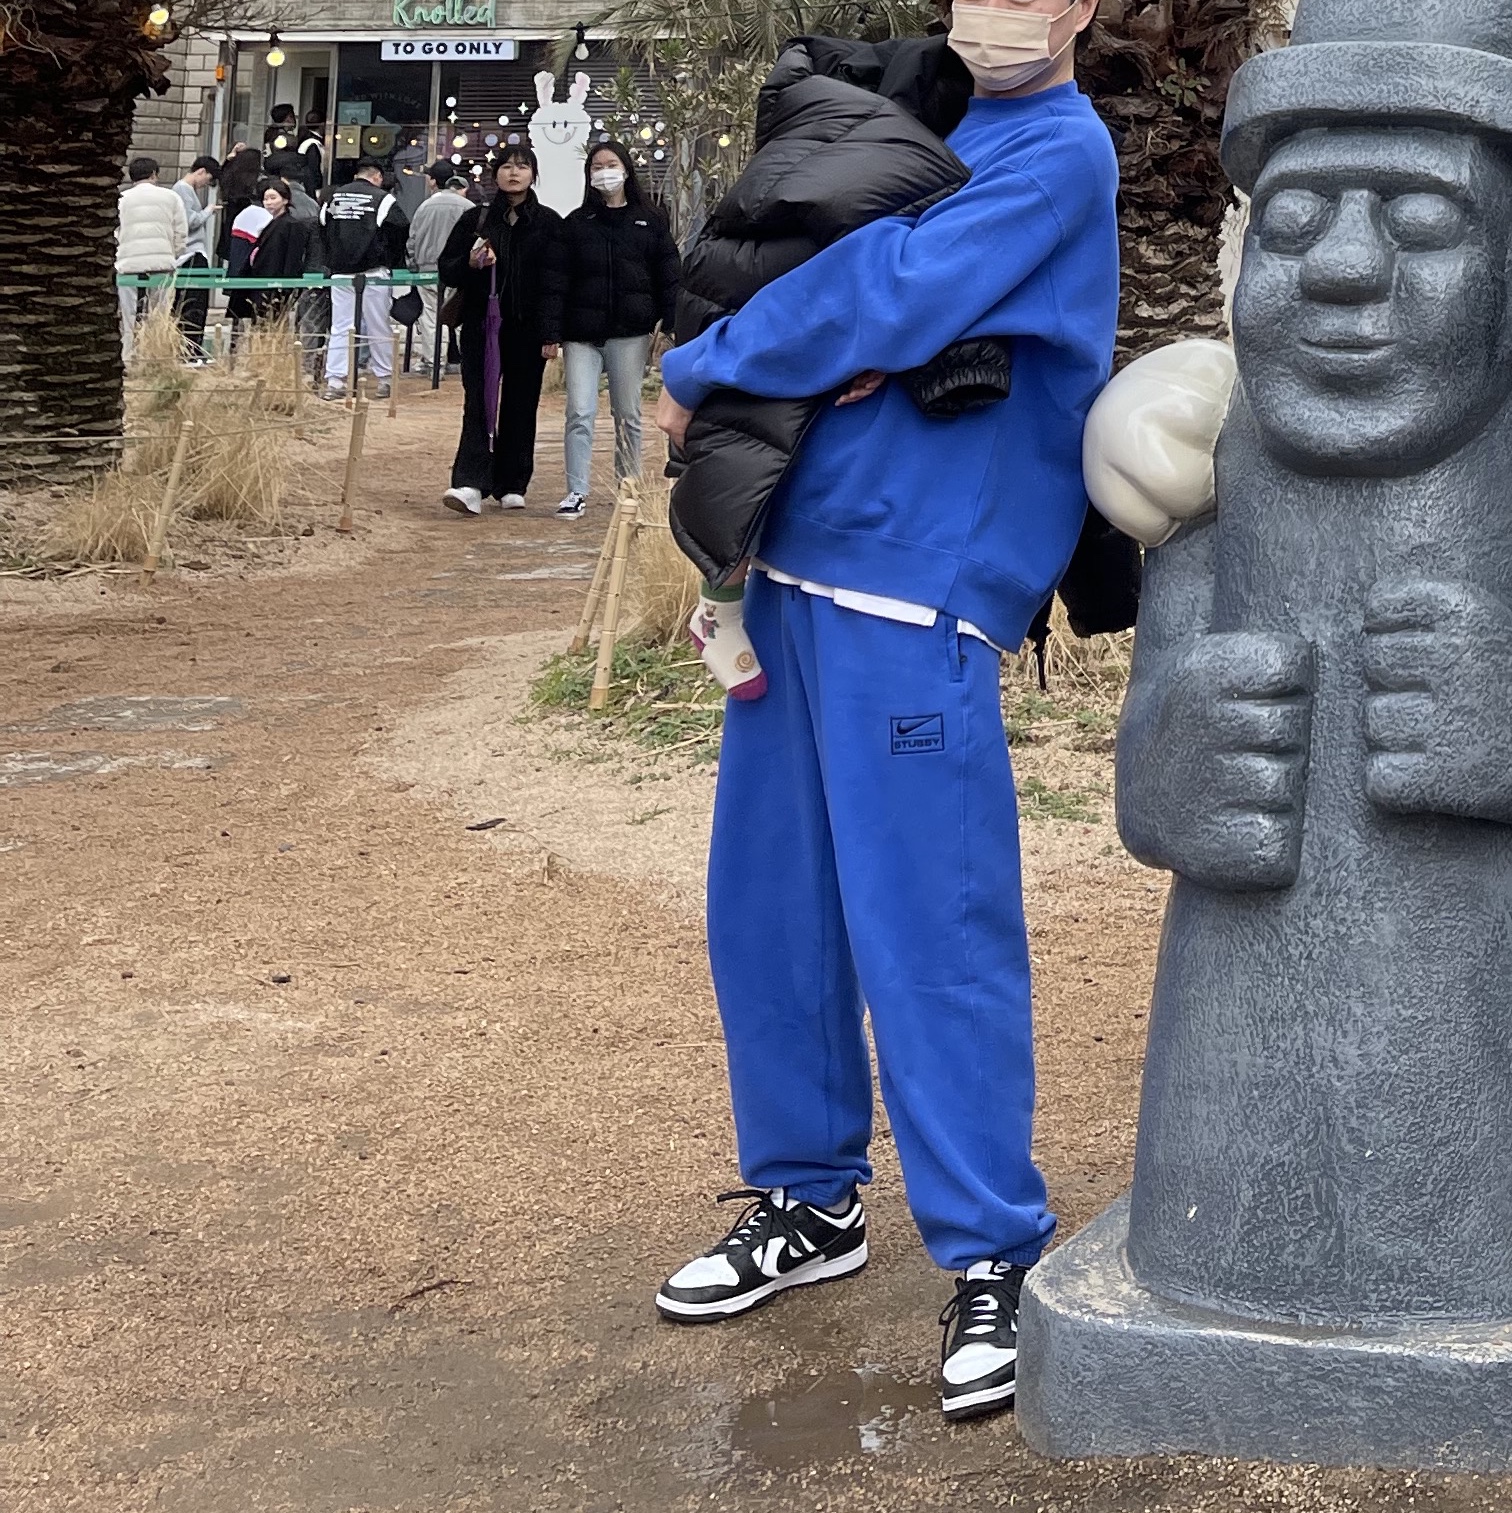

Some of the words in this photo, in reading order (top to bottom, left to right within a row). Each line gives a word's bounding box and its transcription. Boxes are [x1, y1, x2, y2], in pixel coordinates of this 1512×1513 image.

[392, 42, 415, 55] TO
[421, 42, 448, 55] GO
[454, 42, 503, 55] ONLY
